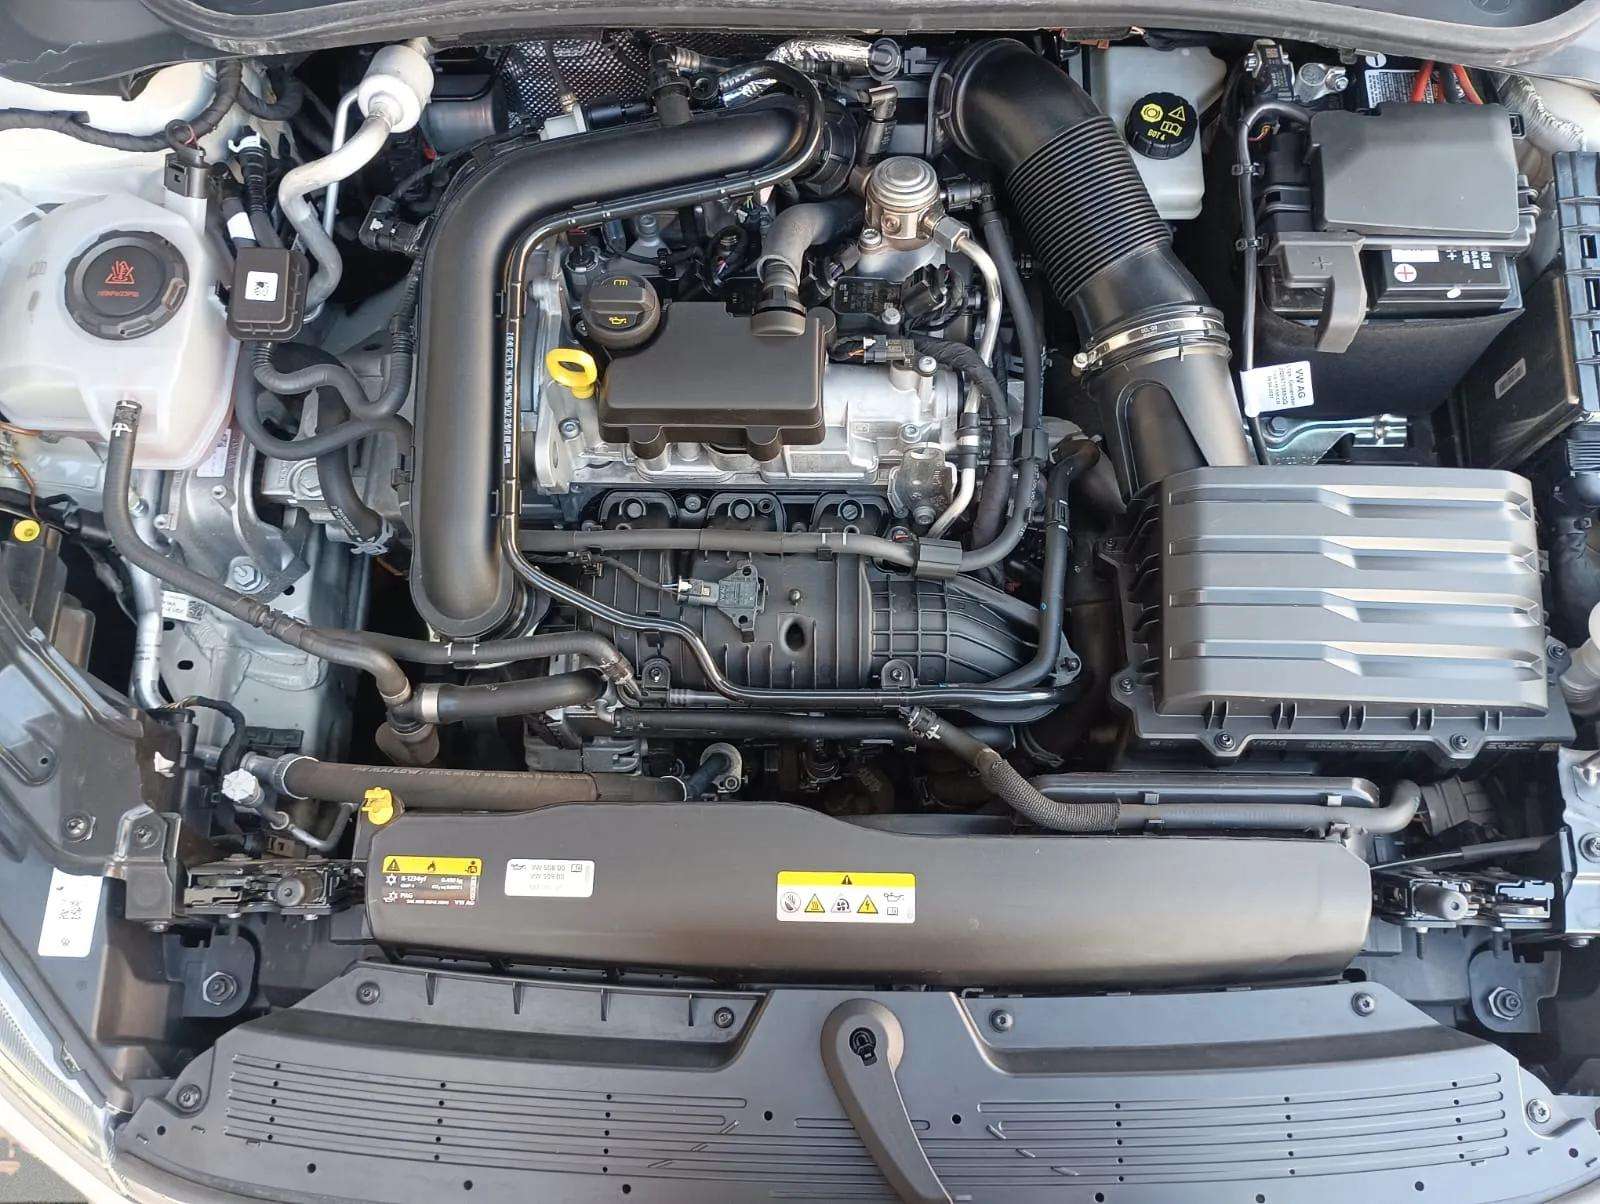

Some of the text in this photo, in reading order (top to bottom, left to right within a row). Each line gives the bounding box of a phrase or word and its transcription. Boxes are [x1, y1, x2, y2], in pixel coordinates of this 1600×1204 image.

[1149, 129, 1162, 139] DOT
[1295, 368, 1306, 399] VW AG
